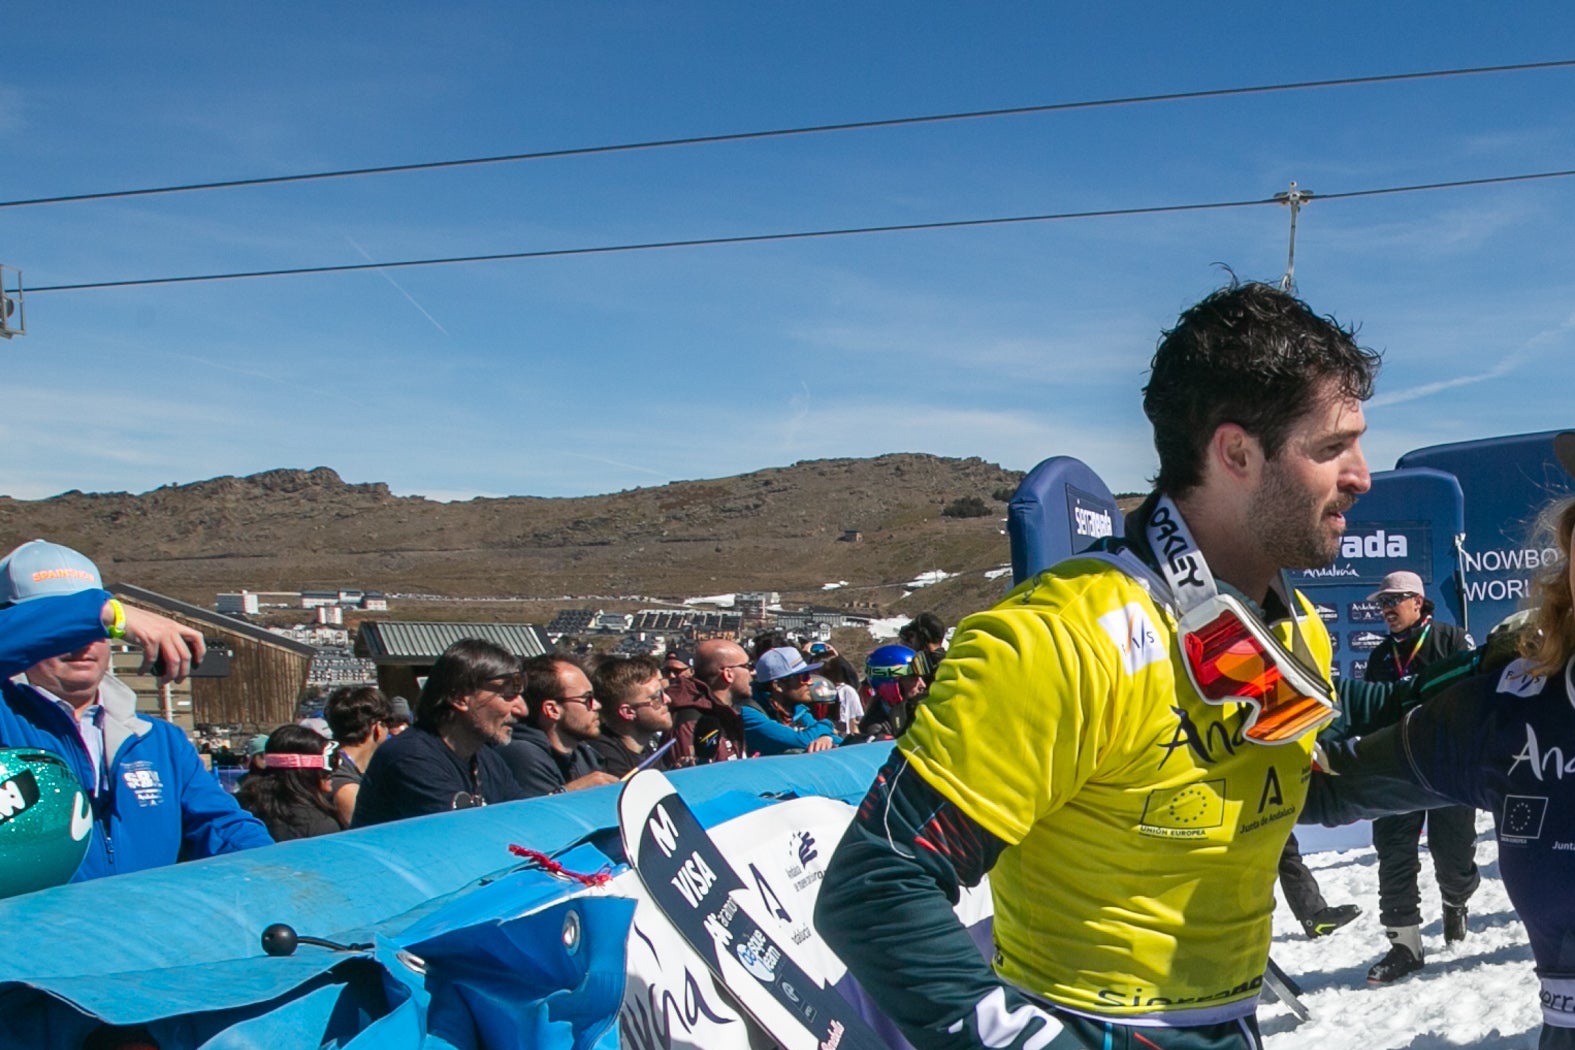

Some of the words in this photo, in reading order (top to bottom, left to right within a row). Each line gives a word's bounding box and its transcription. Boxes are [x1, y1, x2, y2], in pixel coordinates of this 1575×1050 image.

[1150, 506, 1204, 588] OAKLEY
[1465, 548, 1558, 572] NOWBO
[670, 850, 718, 909] VISA
